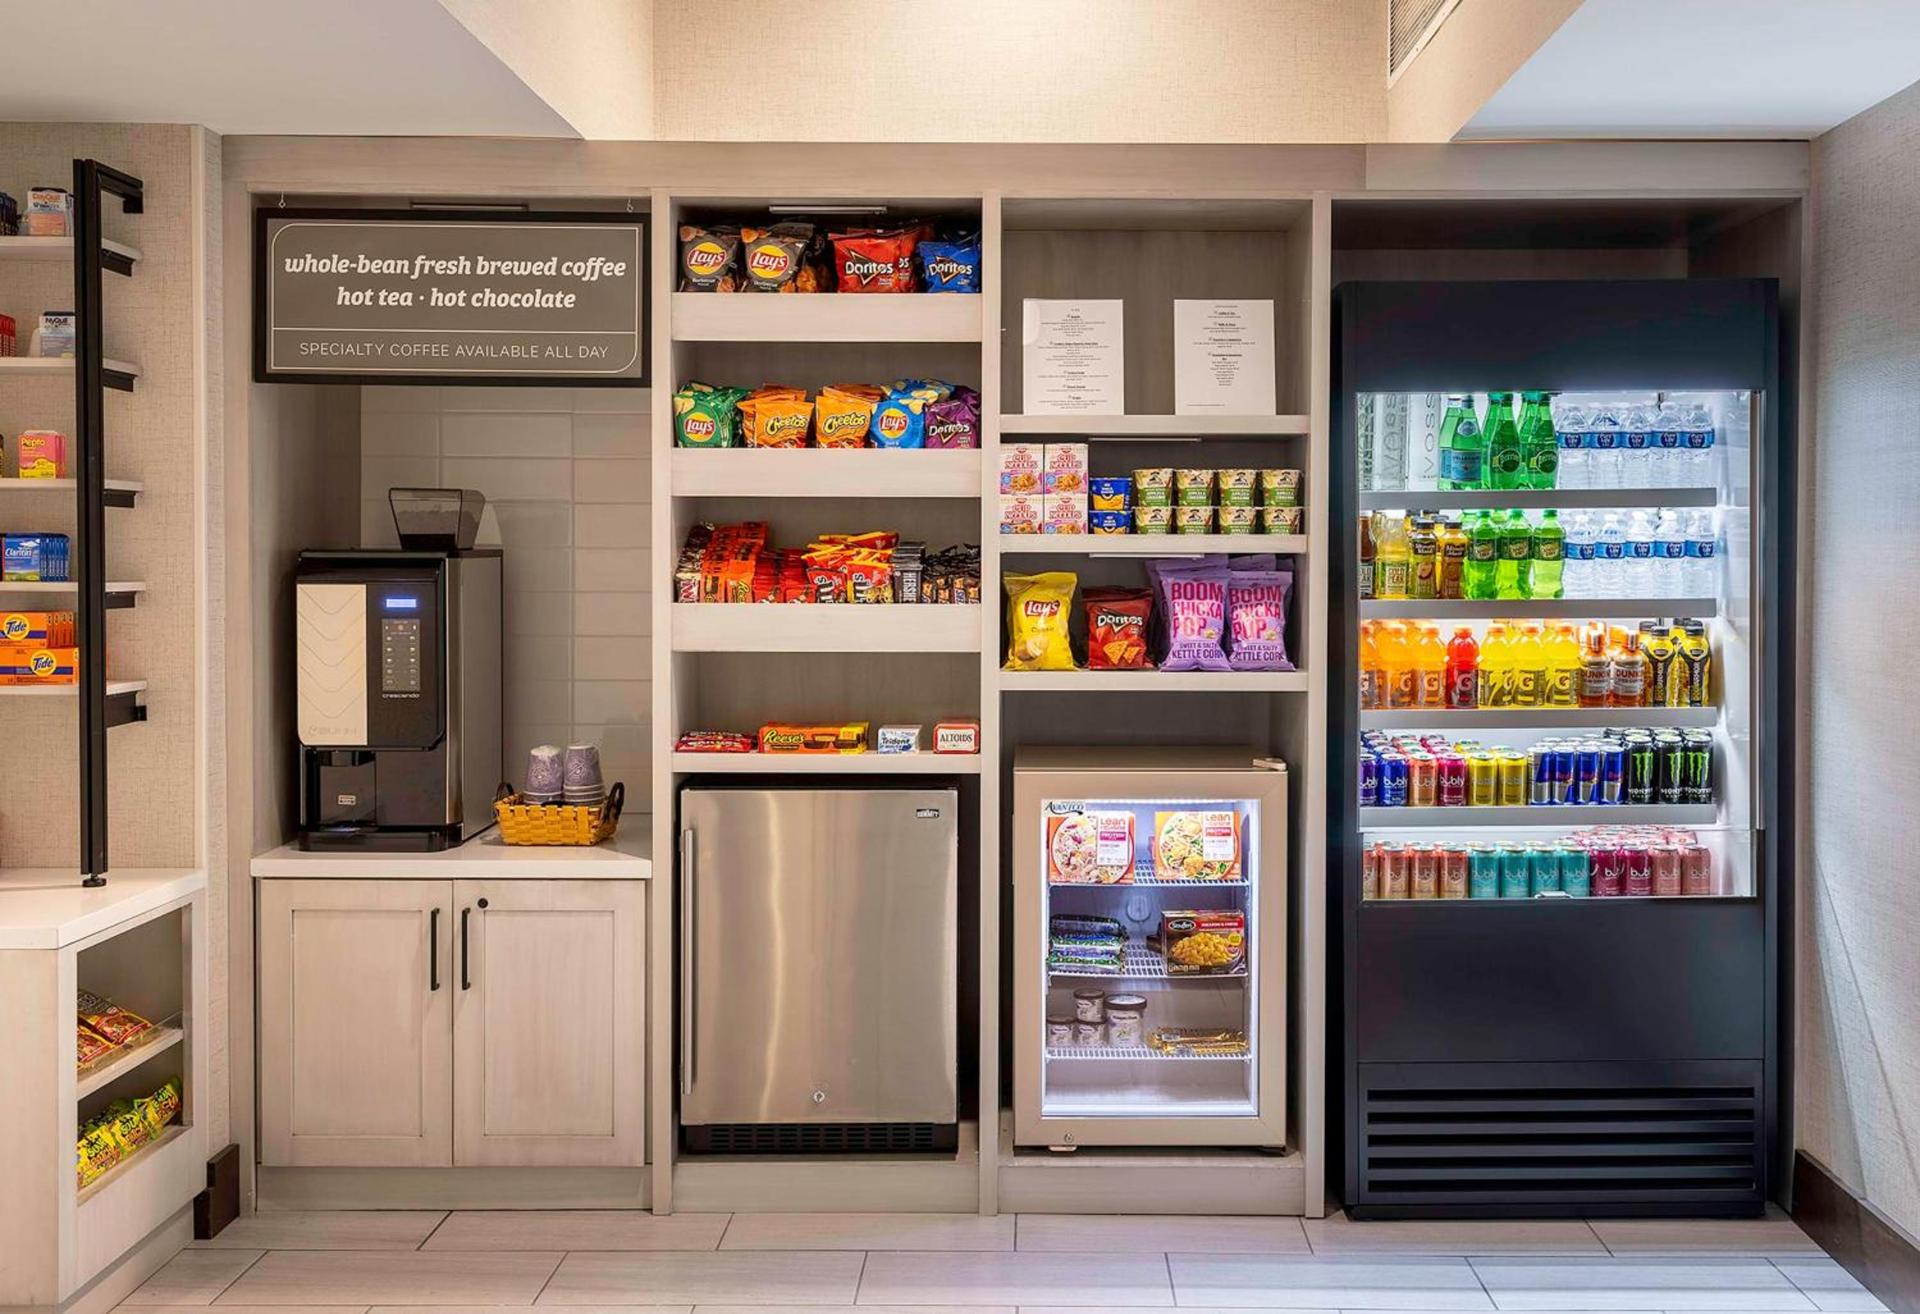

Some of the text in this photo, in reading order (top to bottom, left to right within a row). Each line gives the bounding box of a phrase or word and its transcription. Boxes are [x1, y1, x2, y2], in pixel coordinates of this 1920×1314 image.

[284, 254, 626, 282] whole-bean fresh brewed coffee
[845, 260, 894, 276] Doritos
[928, 262, 973, 277] Doritos
[337, 287, 576, 308] hot tea hot chocolate
[300, 342, 608, 360] SPECIALTY COFFEE AVAILABLE ALL DAY
[686, 418, 716, 435] Lay's
[766, 416, 809, 435] Cheetos
[823, 414, 866, 434] Cheetos
[882, 416, 907, 431] Lay's
[928, 421, 970, 436] Doritos
[1424, 394, 1435, 472] VOSS
[904, 572, 917, 603] HERSHE
[1172, 582, 1224, 602] BOOM
[1229, 586, 1281, 606] BOOM
[1026, 600, 1059, 616] Lay's
[1172, 600, 1222, 620] CHICKA
[5, 620, 27, 635] Tide
[1097, 614, 1143, 626] Doritos
[1173, 617, 1207, 639] POP
[1232, 618, 1268, 643] POP
[1172, 649, 1224, 658] KETTLE CORN
[32, 656, 54, 671] Tide
[763, 729, 806, 745] Reese's
[882, 736, 910, 745] Trident
[940, 734, 972, 742] ALTOIDS
[1440, 776, 1464, 787] bubly
[1100, 818, 1126, 826] Lean
